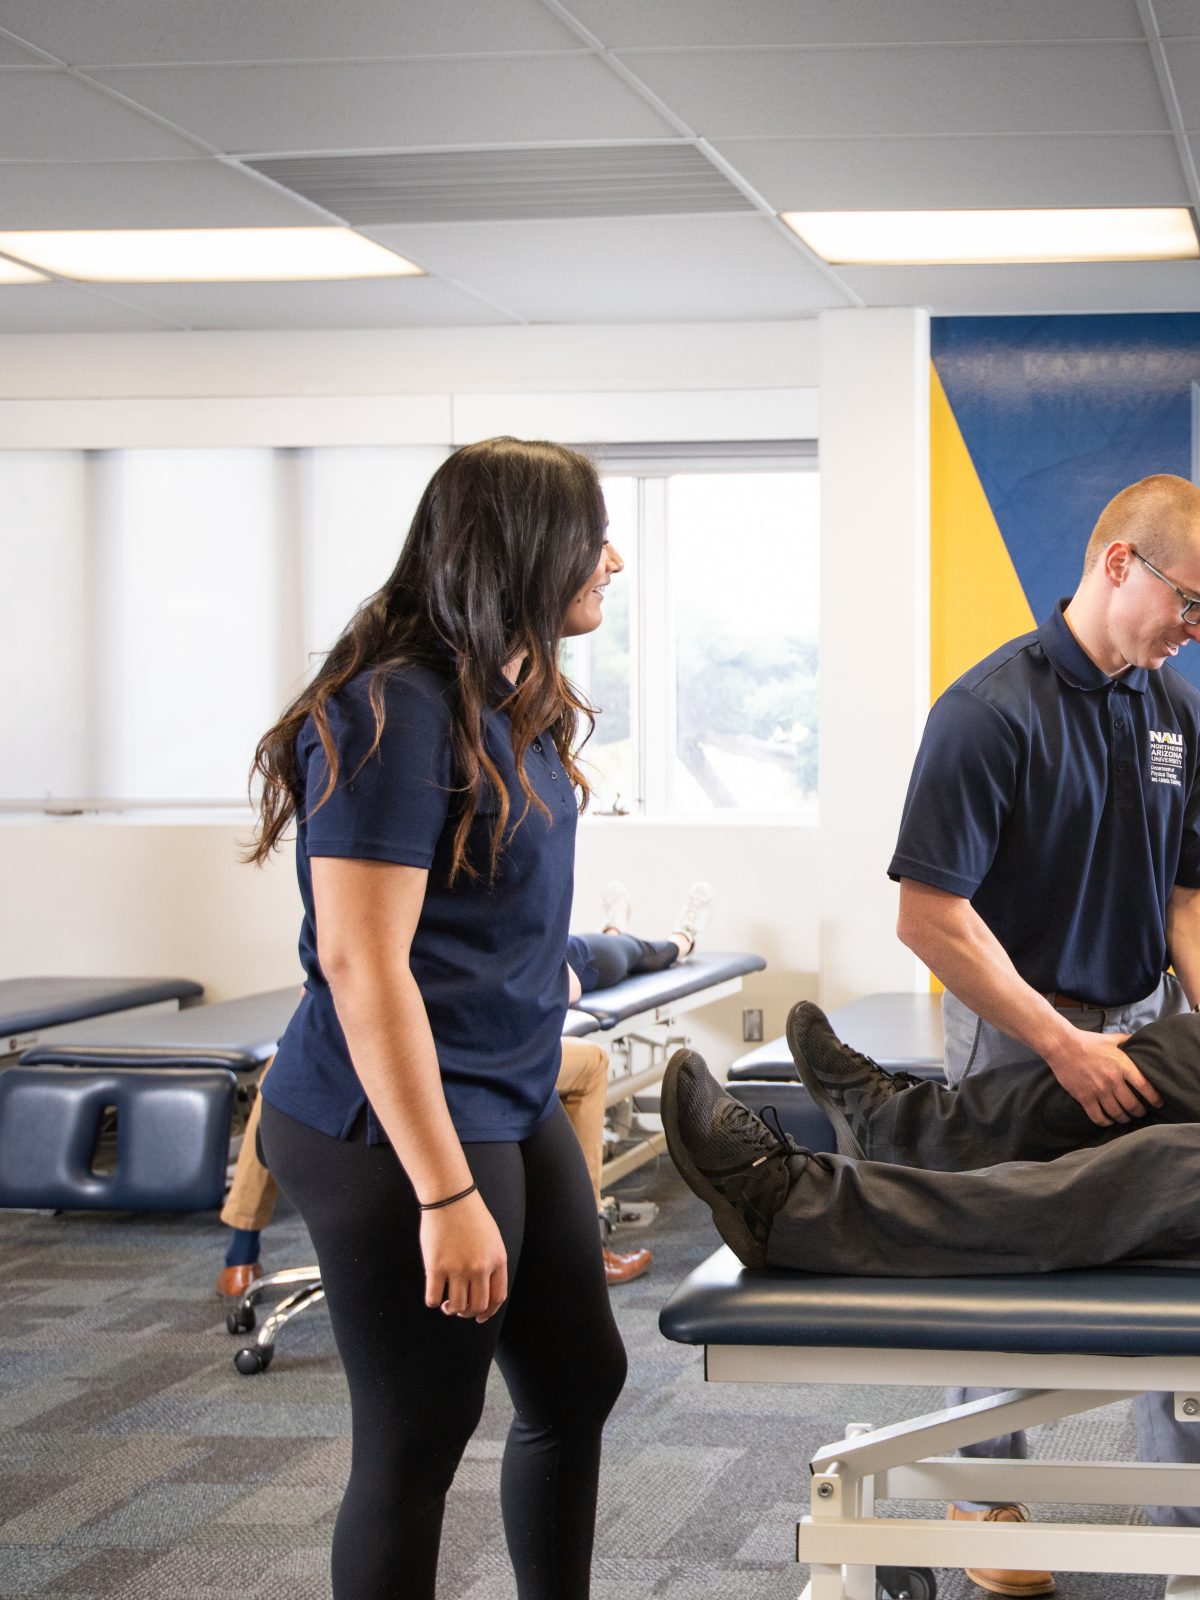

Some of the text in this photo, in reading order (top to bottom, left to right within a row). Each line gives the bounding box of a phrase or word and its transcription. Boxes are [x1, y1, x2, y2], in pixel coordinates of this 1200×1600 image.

[1149, 731, 1183, 745] NAU
[1151, 744, 1183, 752] NORTHERN
[1151, 750, 1182, 759] ARIZONA
[1151, 756, 1182, 765] UNIVERSITY
